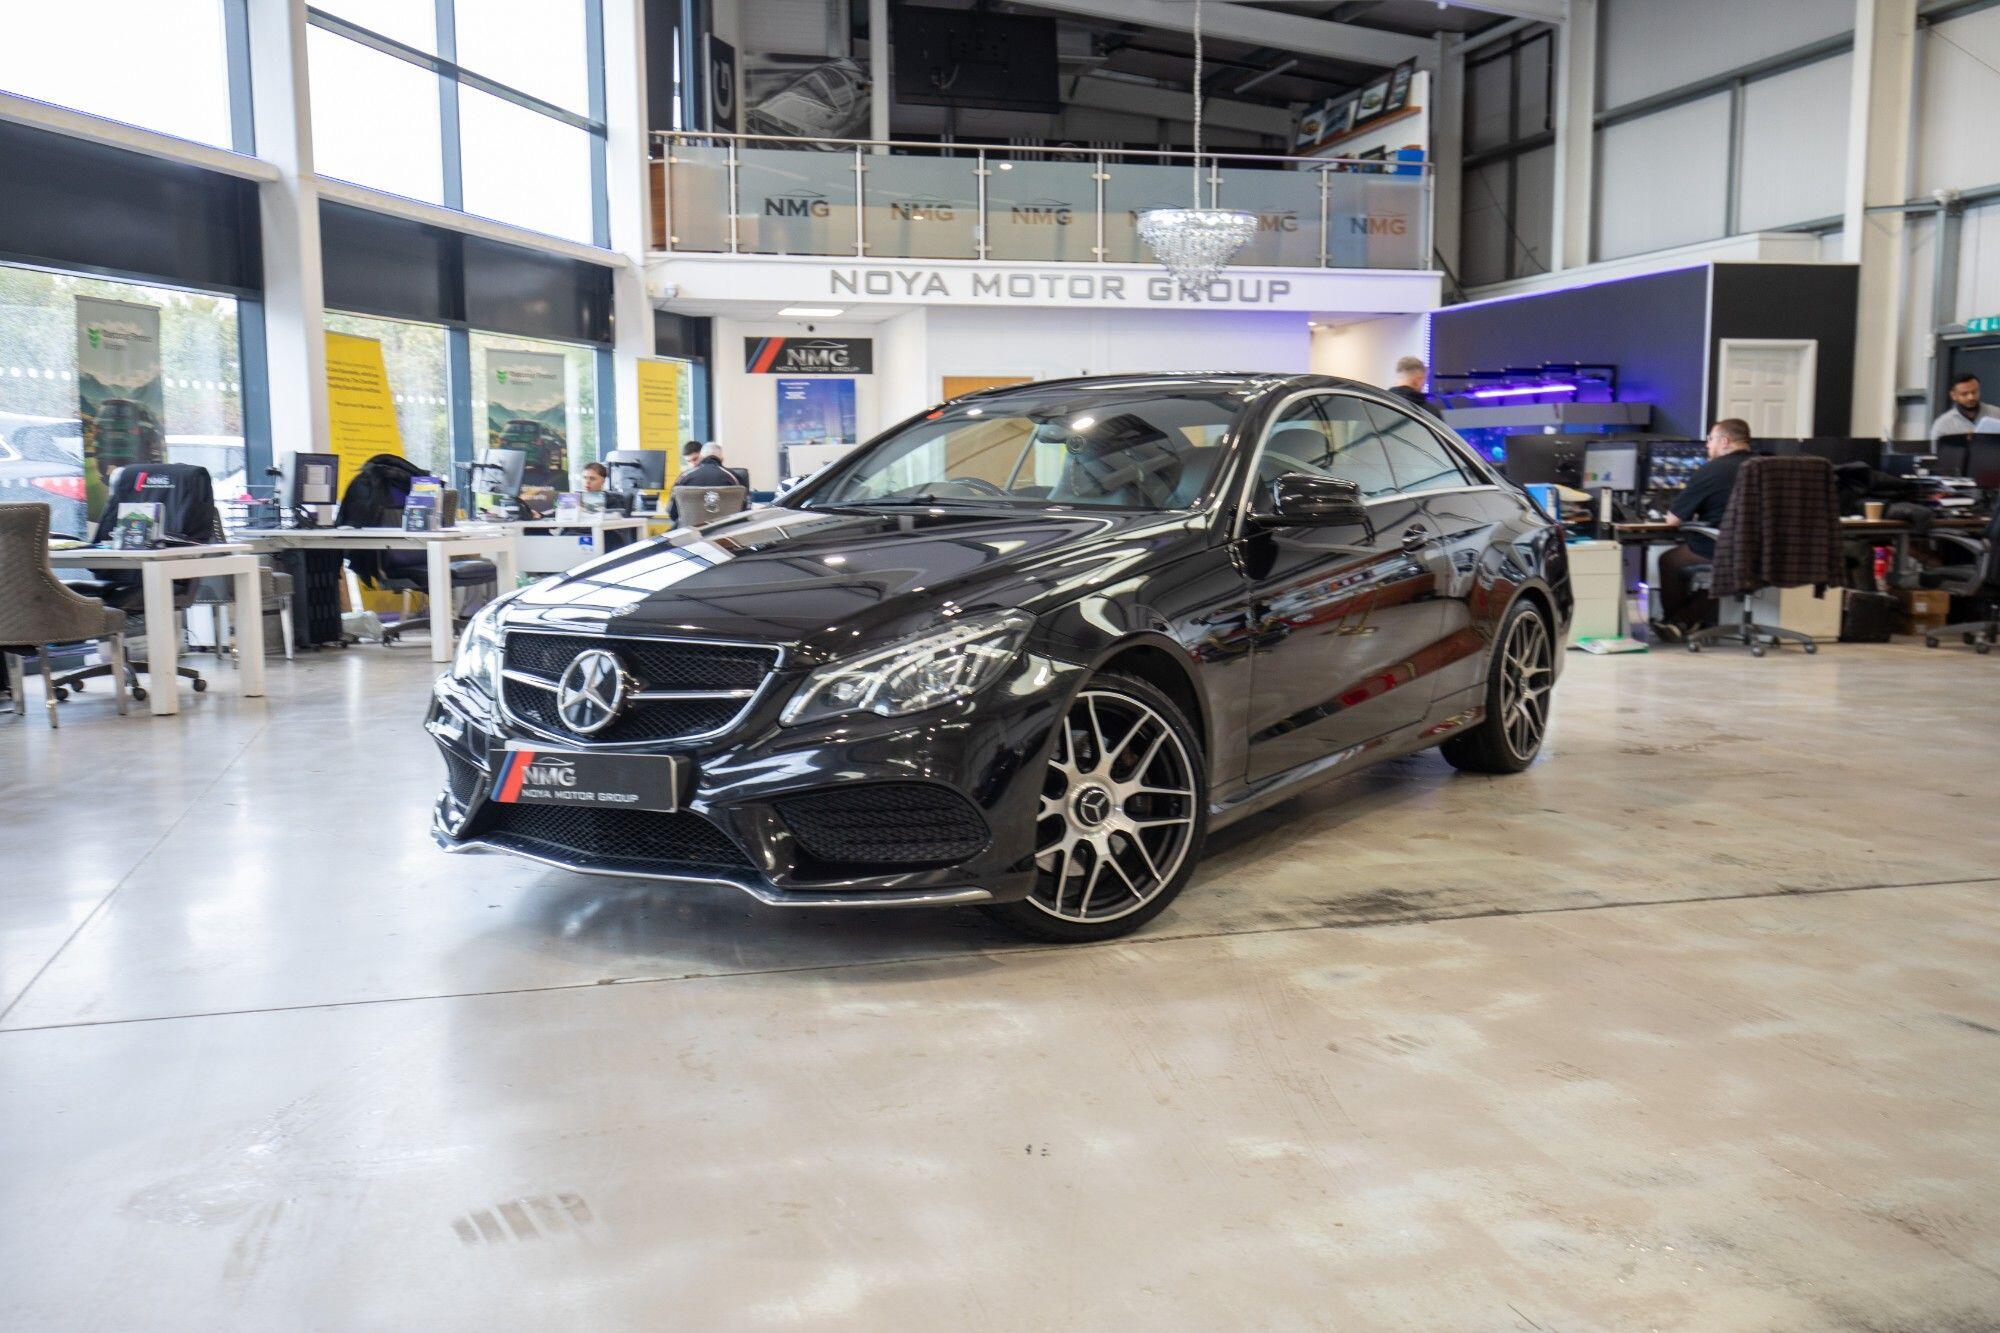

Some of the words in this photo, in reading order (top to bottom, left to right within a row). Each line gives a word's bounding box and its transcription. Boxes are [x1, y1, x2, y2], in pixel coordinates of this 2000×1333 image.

[765, 198, 830, 217] NMG
[891, 202, 955, 221] NMG
[1012, 207, 1072, 225] NMG
[1351, 217, 1406, 235] NMG
[831, 269, 949, 296] NOYA
[972, 272, 1126, 300] MOTOR
[786, 348, 850, 366] NMG
[521, 765, 577, 787] NMG
[521, 789, 552, 799] NOYA
[554, 790, 596, 801] MOTOR
[598, 792, 640, 803] GROUP
